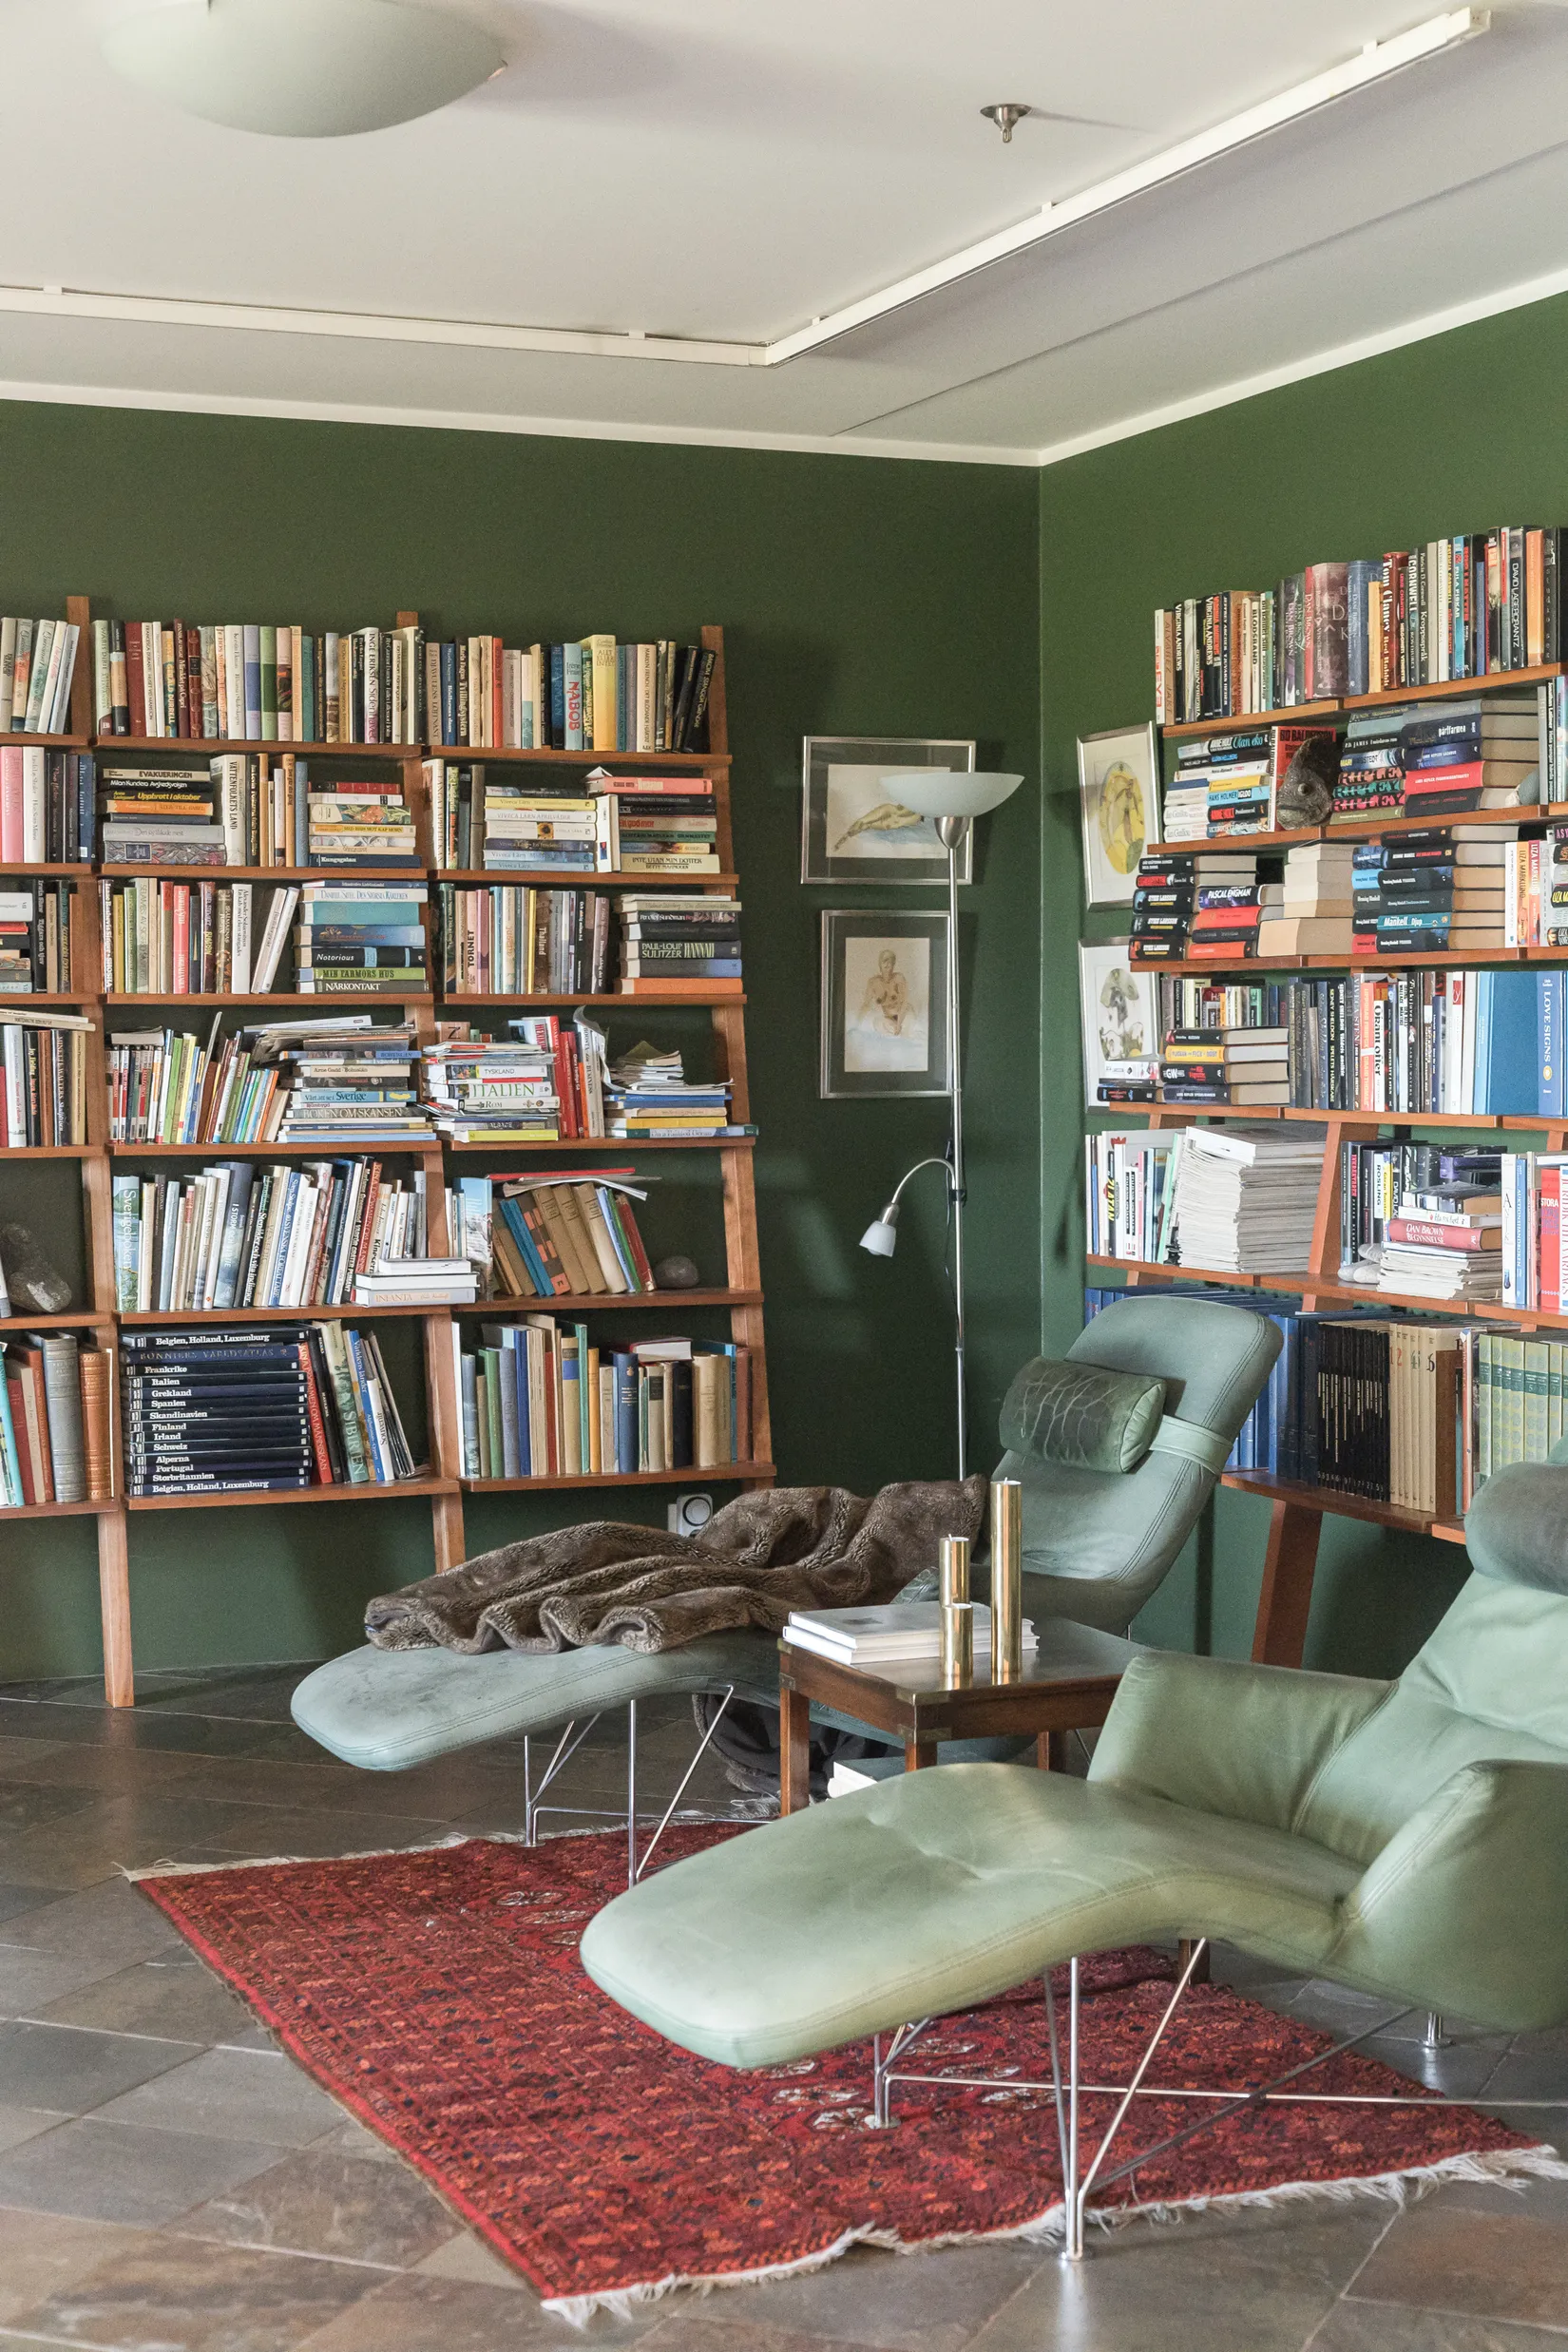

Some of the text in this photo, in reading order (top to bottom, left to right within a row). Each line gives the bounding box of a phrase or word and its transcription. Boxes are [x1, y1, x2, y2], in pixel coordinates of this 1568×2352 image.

[1408, 559, 1417, 612] CORNWELL
[1382, 557, 1393, 633] Tom Clancy
[1419, 610, 1427, 662] Kroppsspråk
[566, 681, 581, 731] NABOB
[139, 771, 193, 779] EVAKUERINGEN
[229, 761, 238, 812] VATTENFOLKETS
[137, 792, 170, 801] Uppbrott
[1209, 791, 1237, 802] HANS HOLMER
[1207, 888, 1252, 899] PASCAL ENGMAN
[1384, 916, 1408, 927] Mankell
[538, 927, 547, 956] Thailand
[316, 953, 354, 962] Notorious
[379, 969, 395, 979] HUS
[325, 983, 381, 991] NÄRKONTAKT
[448, 1026, 461, 1040] Z
[335, 1091, 367, 1102] Sverige
[472, 1083, 535, 1098] ITALIEN
[304, 1107, 403, 1119] BOKEN OM SKANSEN
[1540, 1197, 1558, 1209] STORA
[229, 1208, 239, 1230] STORM
[120, 1190, 137, 1271] Sverigeboken
[352, 1224, 362, 1247] VARFÖR
[1406, 1223, 1444, 1236] DAN BROWN
[279, 1220, 292, 1253] SVENSKA
[155, 1333, 271, 1346] Belgien, Holland, Luxemburg
[144, 1366, 188, 1374] Frankrike
[151, 1400, 187, 1408] Spanien
[151, 1423, 187, 1431] Finland
[343, 1410, 365, 1475] SIBIRIEN
[156, 1456, 190, 1464] Alperna
[156, 1464, 195, 1474] Portugal
[152, 1484, 186, 1493] Belgien,
[222, 1481, 270, 1491] Luxemburg
